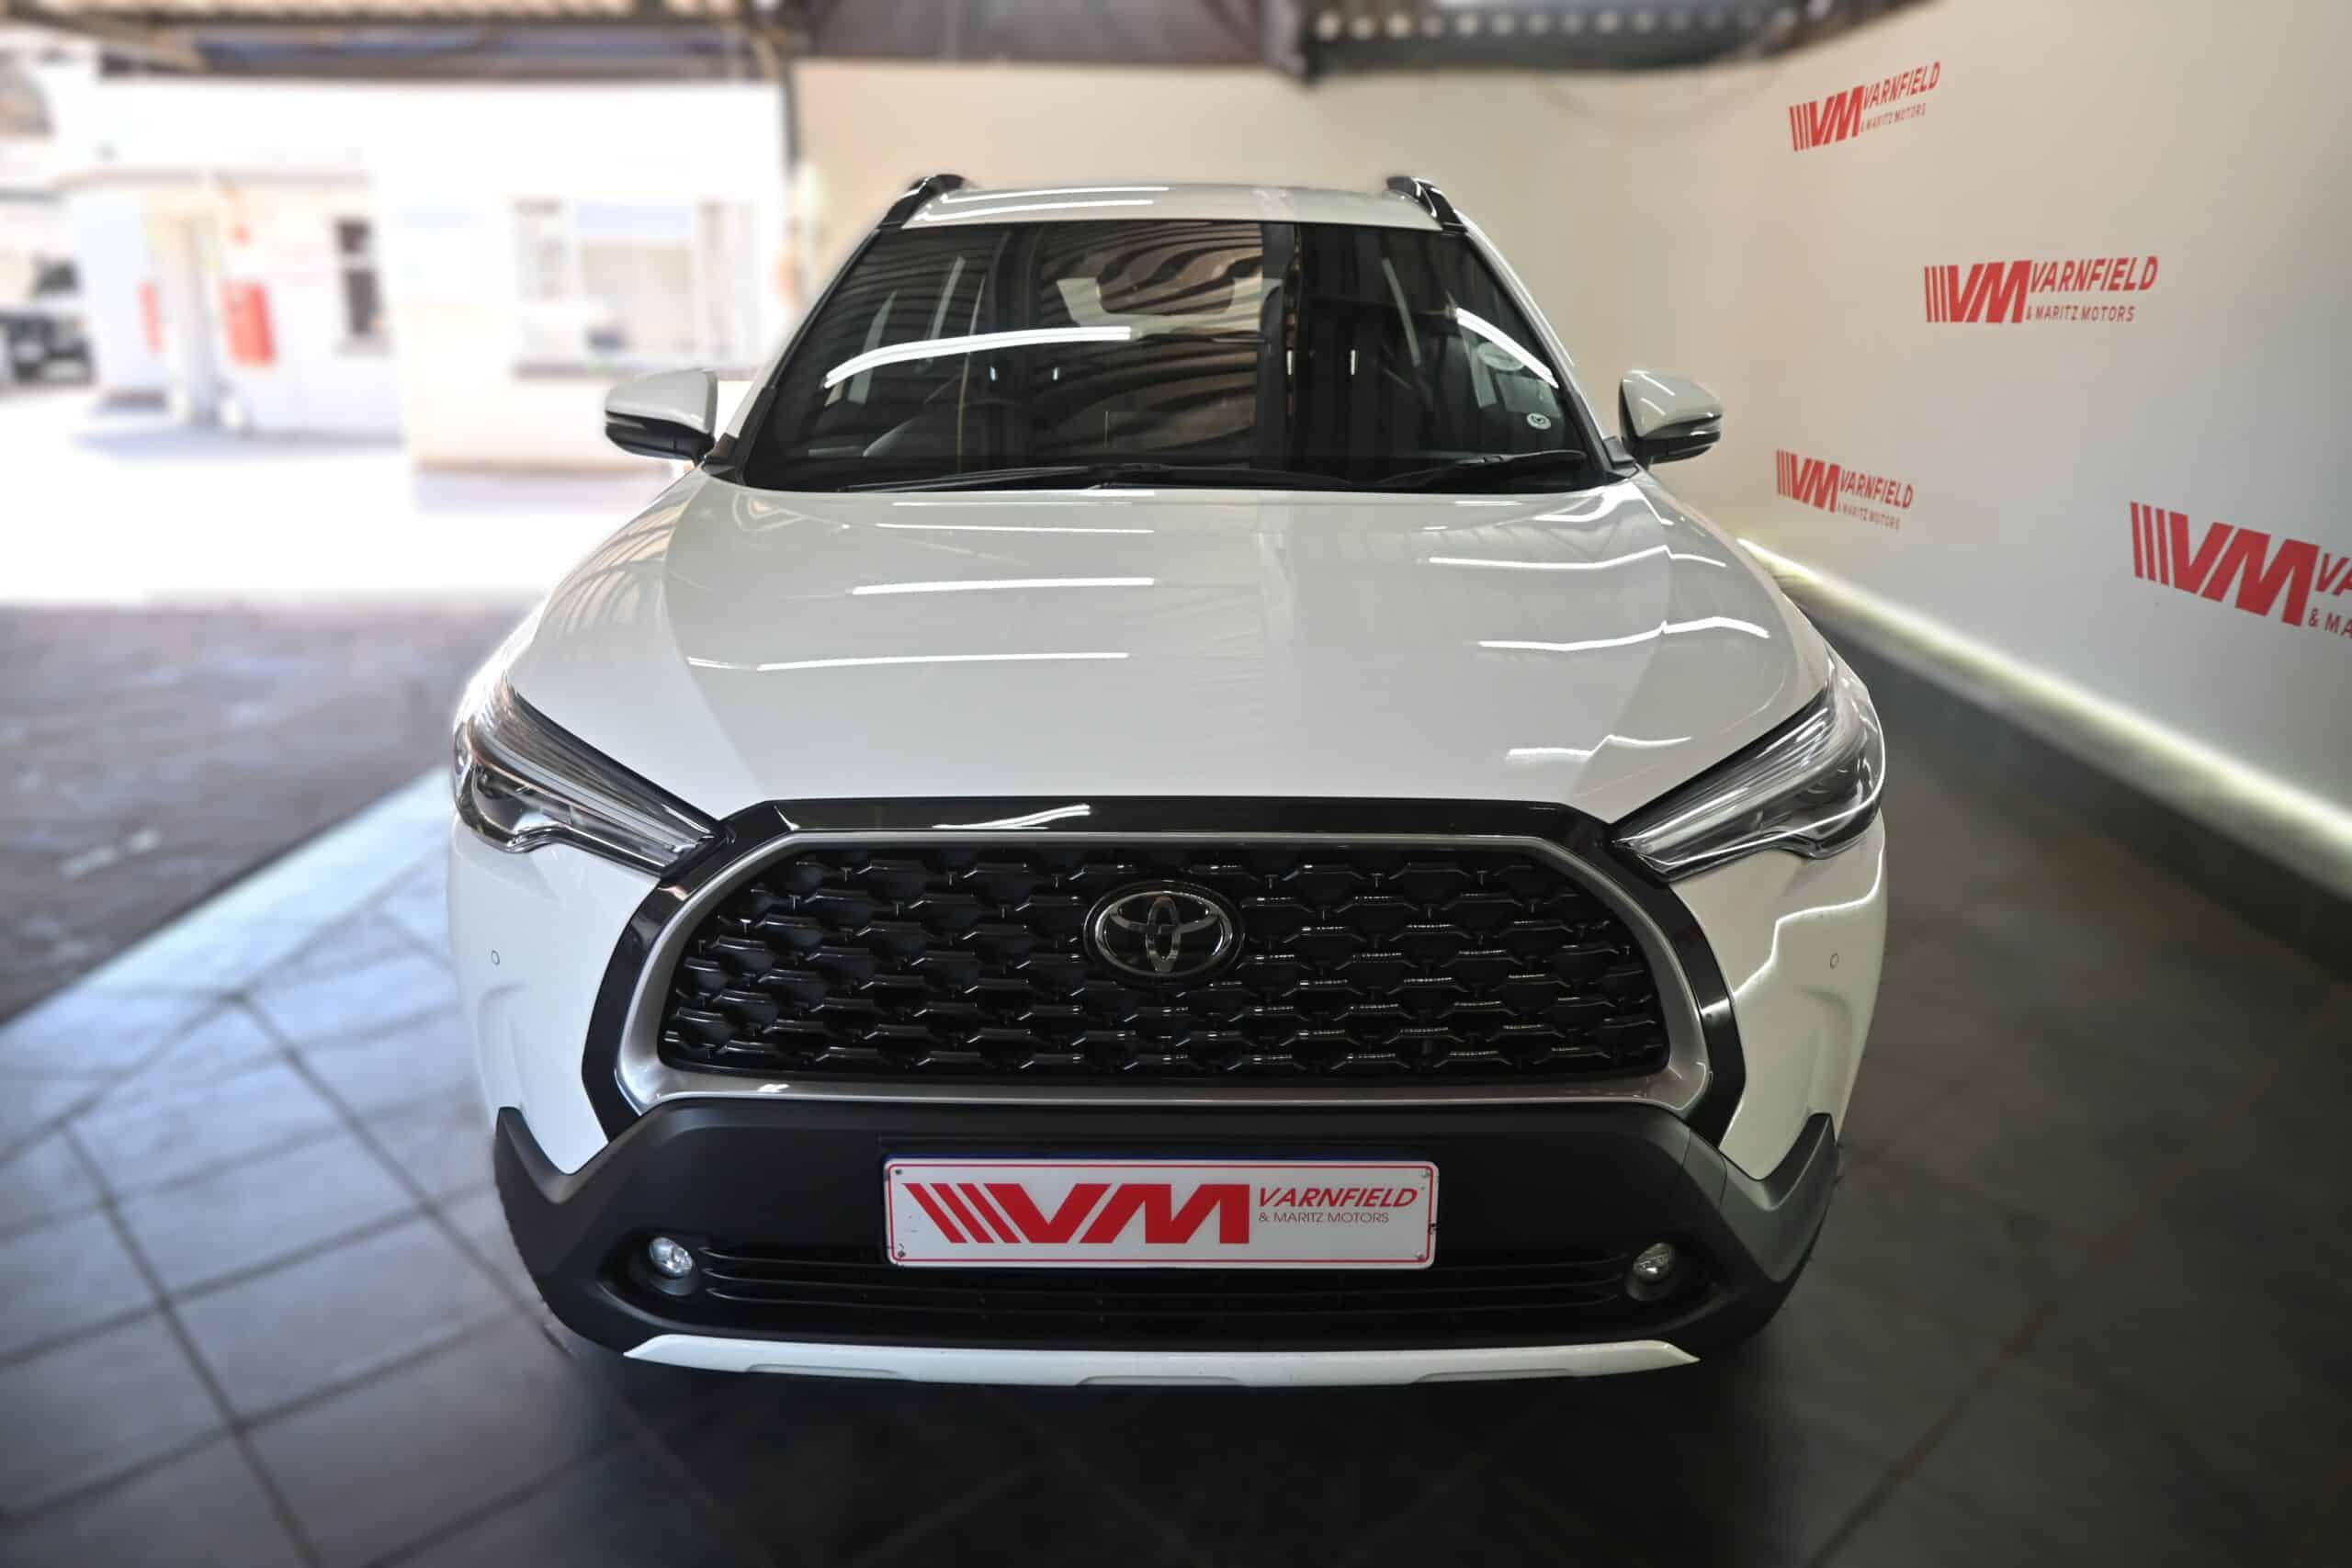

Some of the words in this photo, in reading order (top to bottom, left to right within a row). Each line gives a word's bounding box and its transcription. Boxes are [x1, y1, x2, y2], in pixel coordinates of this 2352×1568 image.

[1863, 62, 1940, 110] VARNFIELD
[2030, 255, 2158, 293] VARNFIELD
[2036, 305, 2078, 321] MARITZ
[2080, 305, 2135, 322] MOTORS
[1840, 469, 1914, 509] VARNFIELD
[2309, 607, 2318, 626] &
[1258, 1187, 1419, 1208] VARNFIELD
[1259, 1212, 1270, 1224] &
[1273, 1212, 1324, 1224] MARITZ
[1327, 1212, 1390, 1224] MOTORS
